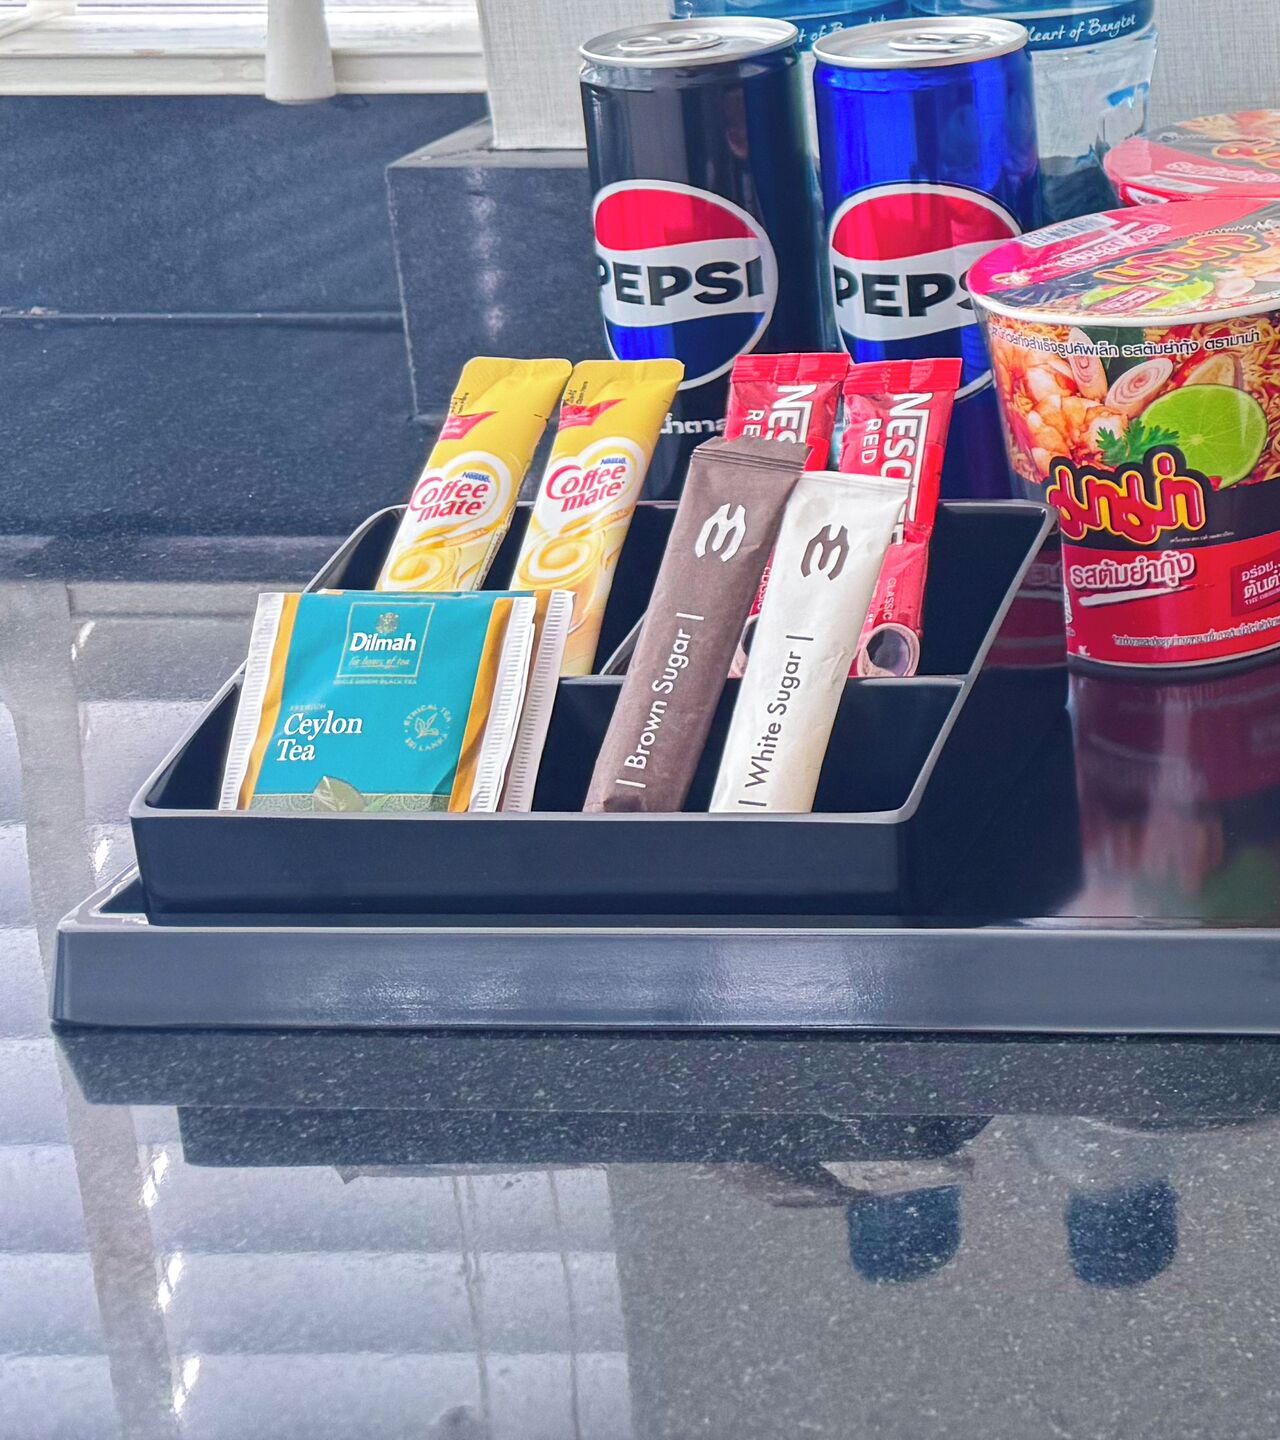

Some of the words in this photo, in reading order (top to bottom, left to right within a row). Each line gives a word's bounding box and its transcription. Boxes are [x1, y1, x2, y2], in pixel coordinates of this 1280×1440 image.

[1069, 23, 1086, 43] of
[742, 409, 766, 439] RE
[861, 417, 883, 465] RED
[409, 476, 489, 512] Coffee
[546, 464, 626, 500] Coffee
[561, 483, 622, 513] mate
[1046, 452, 1207, 545] มาม่า
[417, 498, 485, 523] mate
[882, 577, 898, 621] CLASSIC
[349, 632, 417, 652] Dilmah
[624, 700, 668, 770] Brown
[651, 628, 692, 695] Sugar
[284, 710, 363, 742] Ceylon
[745, 722, 782, 788] White
[767, 651, 802, 716] Sugar
[276, 738, 316, 761] Tea
